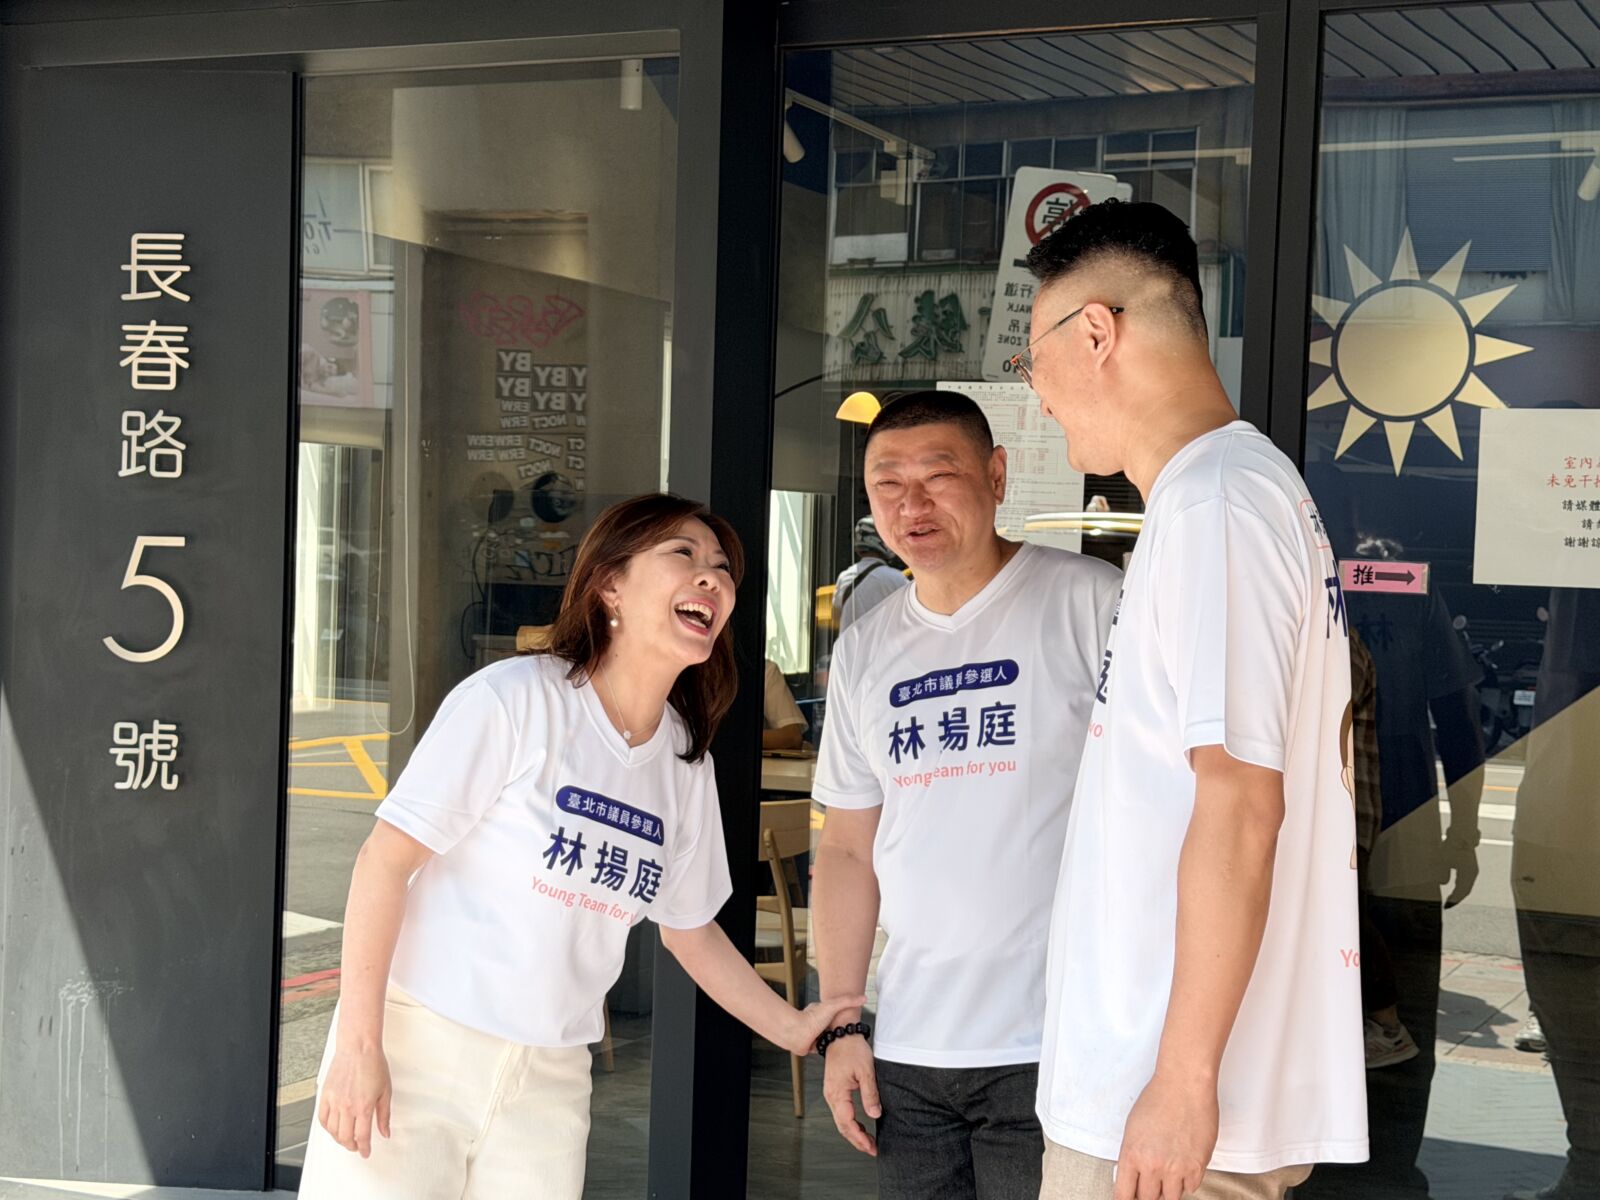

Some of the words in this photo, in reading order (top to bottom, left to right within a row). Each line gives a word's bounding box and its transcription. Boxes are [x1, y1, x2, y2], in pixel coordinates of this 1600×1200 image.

[1564, 456, 1600, 470] 室內
[1352, 564, 1374, 586] 推
[988, 760, 1016, 777] you
[567, 792, 662, 840] 臺北市議員參選人
[542, 826, 664, 904] 林揚庭
[531, 876, 576, 908] Young
[578, 893, 608, 914] Team
[608, 903, 627, 920] for
